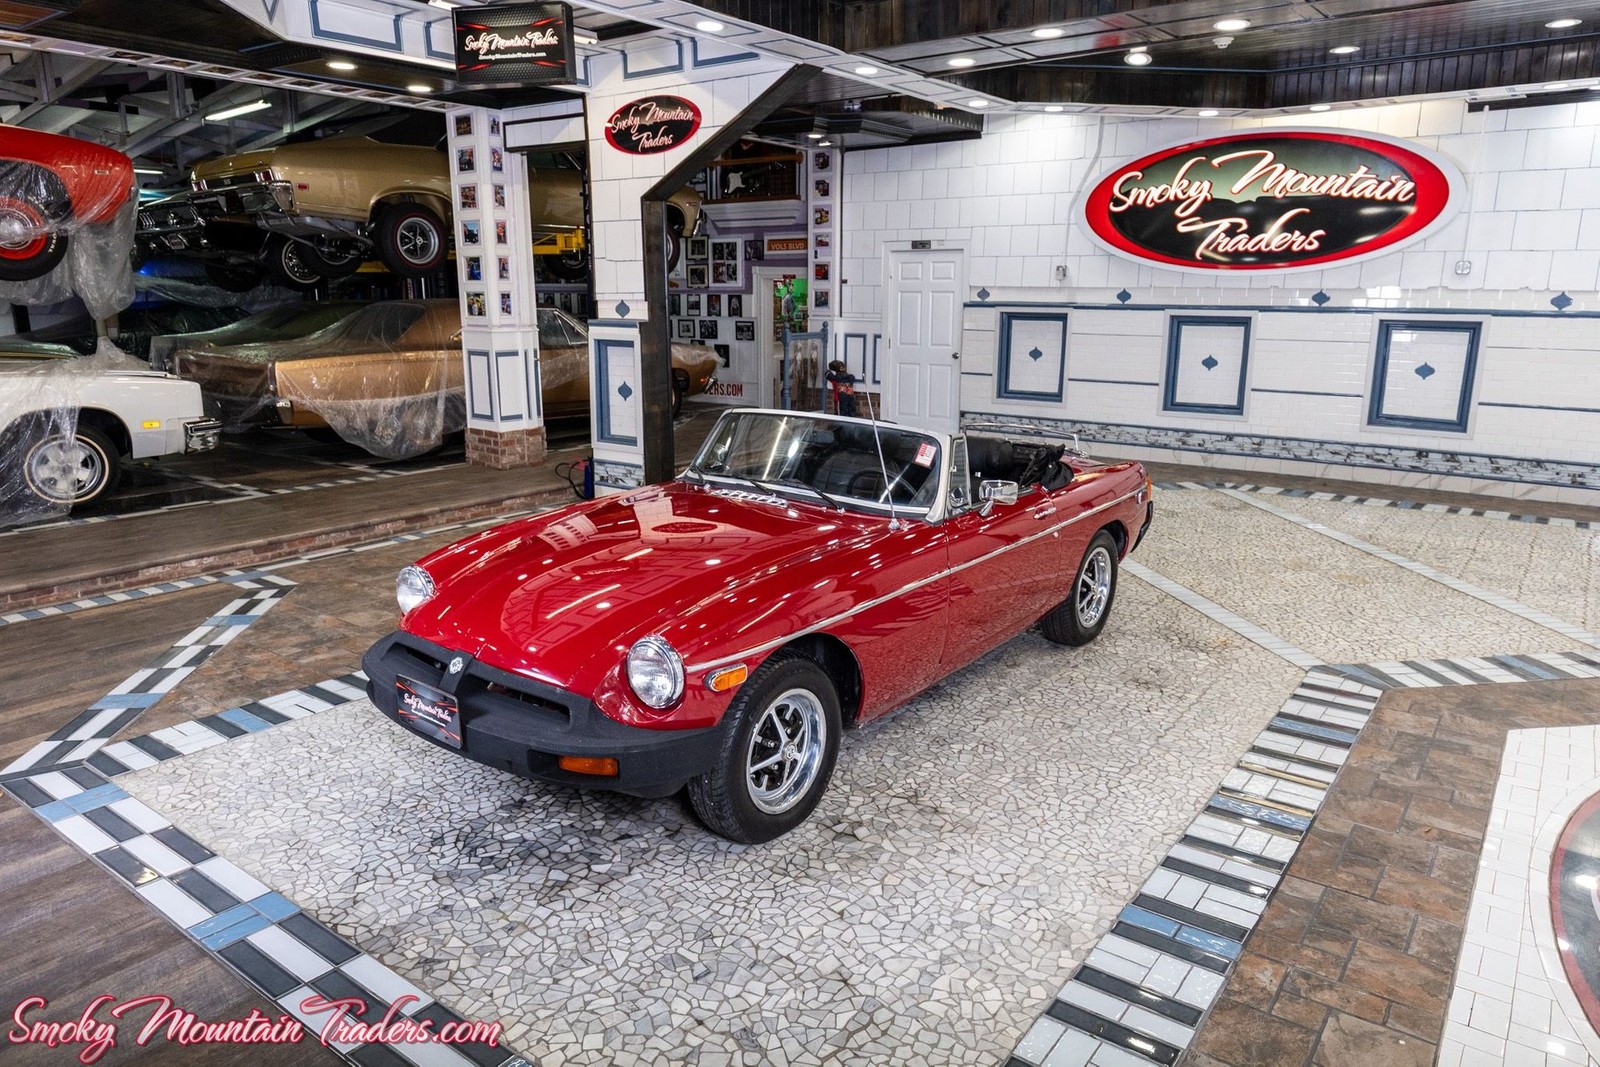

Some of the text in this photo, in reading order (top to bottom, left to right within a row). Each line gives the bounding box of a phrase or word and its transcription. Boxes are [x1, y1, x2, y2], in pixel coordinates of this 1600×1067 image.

[464, 28, 559, 55] Smoky Mountain Traders
[611, 101, 695, 134] Smoky Mountain
[632, 126, 673, 152] Traders
[1109, 150, 1417, 218] Smoky Mountain
[788, 242, 805, 250] BLVD
[1176, 208, 1327, 261] Traders
